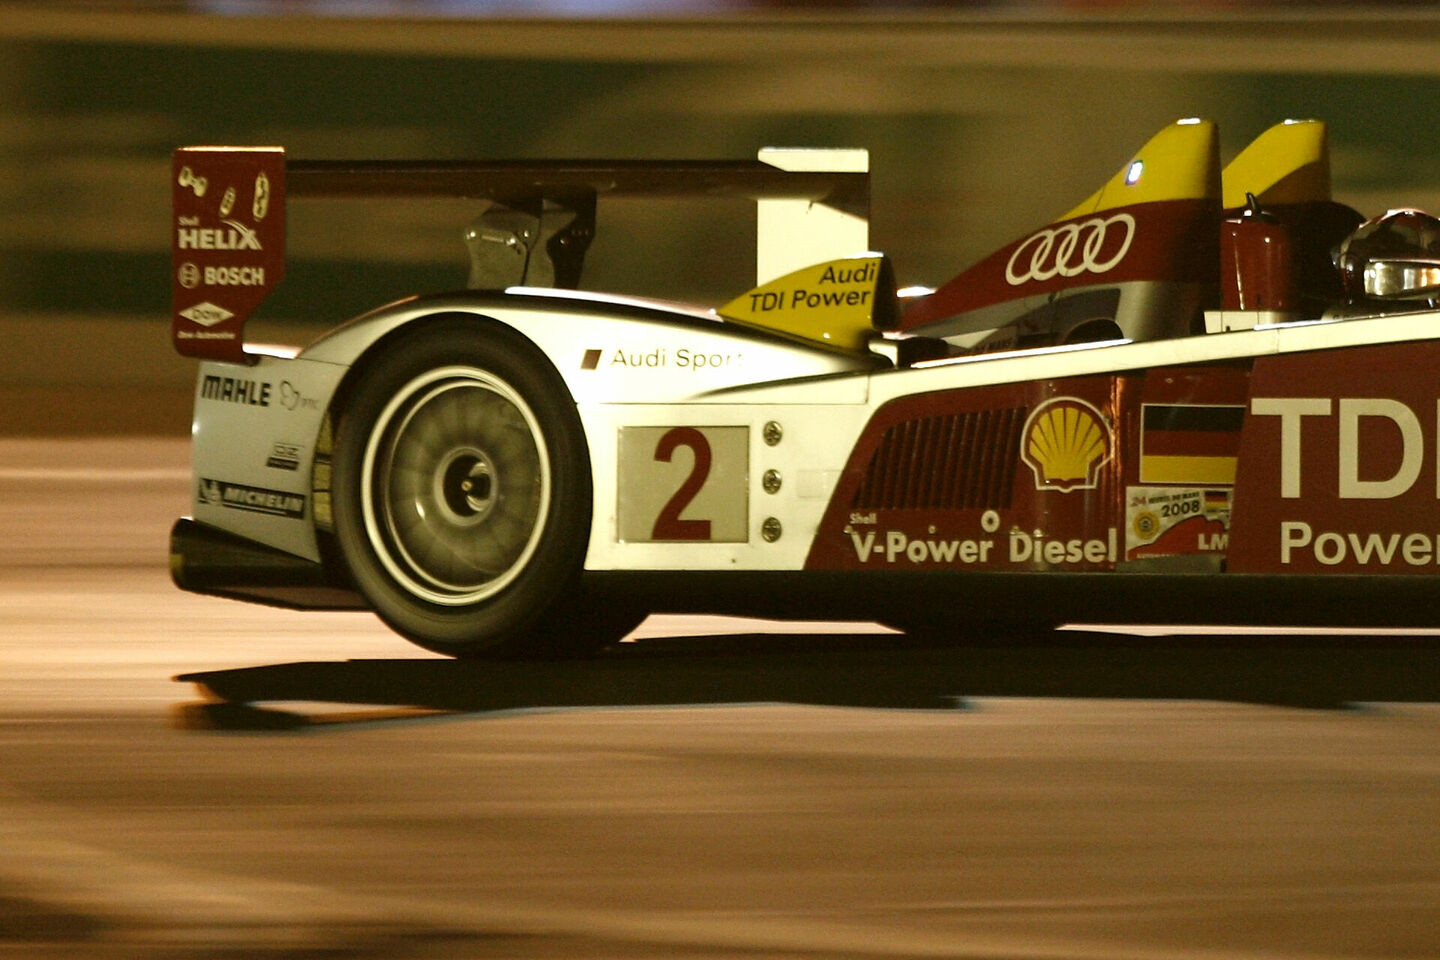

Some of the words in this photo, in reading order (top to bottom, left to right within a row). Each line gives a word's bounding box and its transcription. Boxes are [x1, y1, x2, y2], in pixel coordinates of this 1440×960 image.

[178, 228, 262, 249] HELIX
[204, 266, 264, 286] BOSCH
[819, 263, 876, 285] Audi
[750, 293, 783, 312] TDI
[792, 289, 871, 309] Power
[610, 348, 667, 367] Audi
[202, 375, 272, 407] MAHLE
[652, 426, 712, 540] 2
[849, 512, 877, 525] Shell
[1161, 501, 1200, 517] 2008
[850, 531, 994, 563] V-Power
[1009, 527, 1118, 564] Diesel
